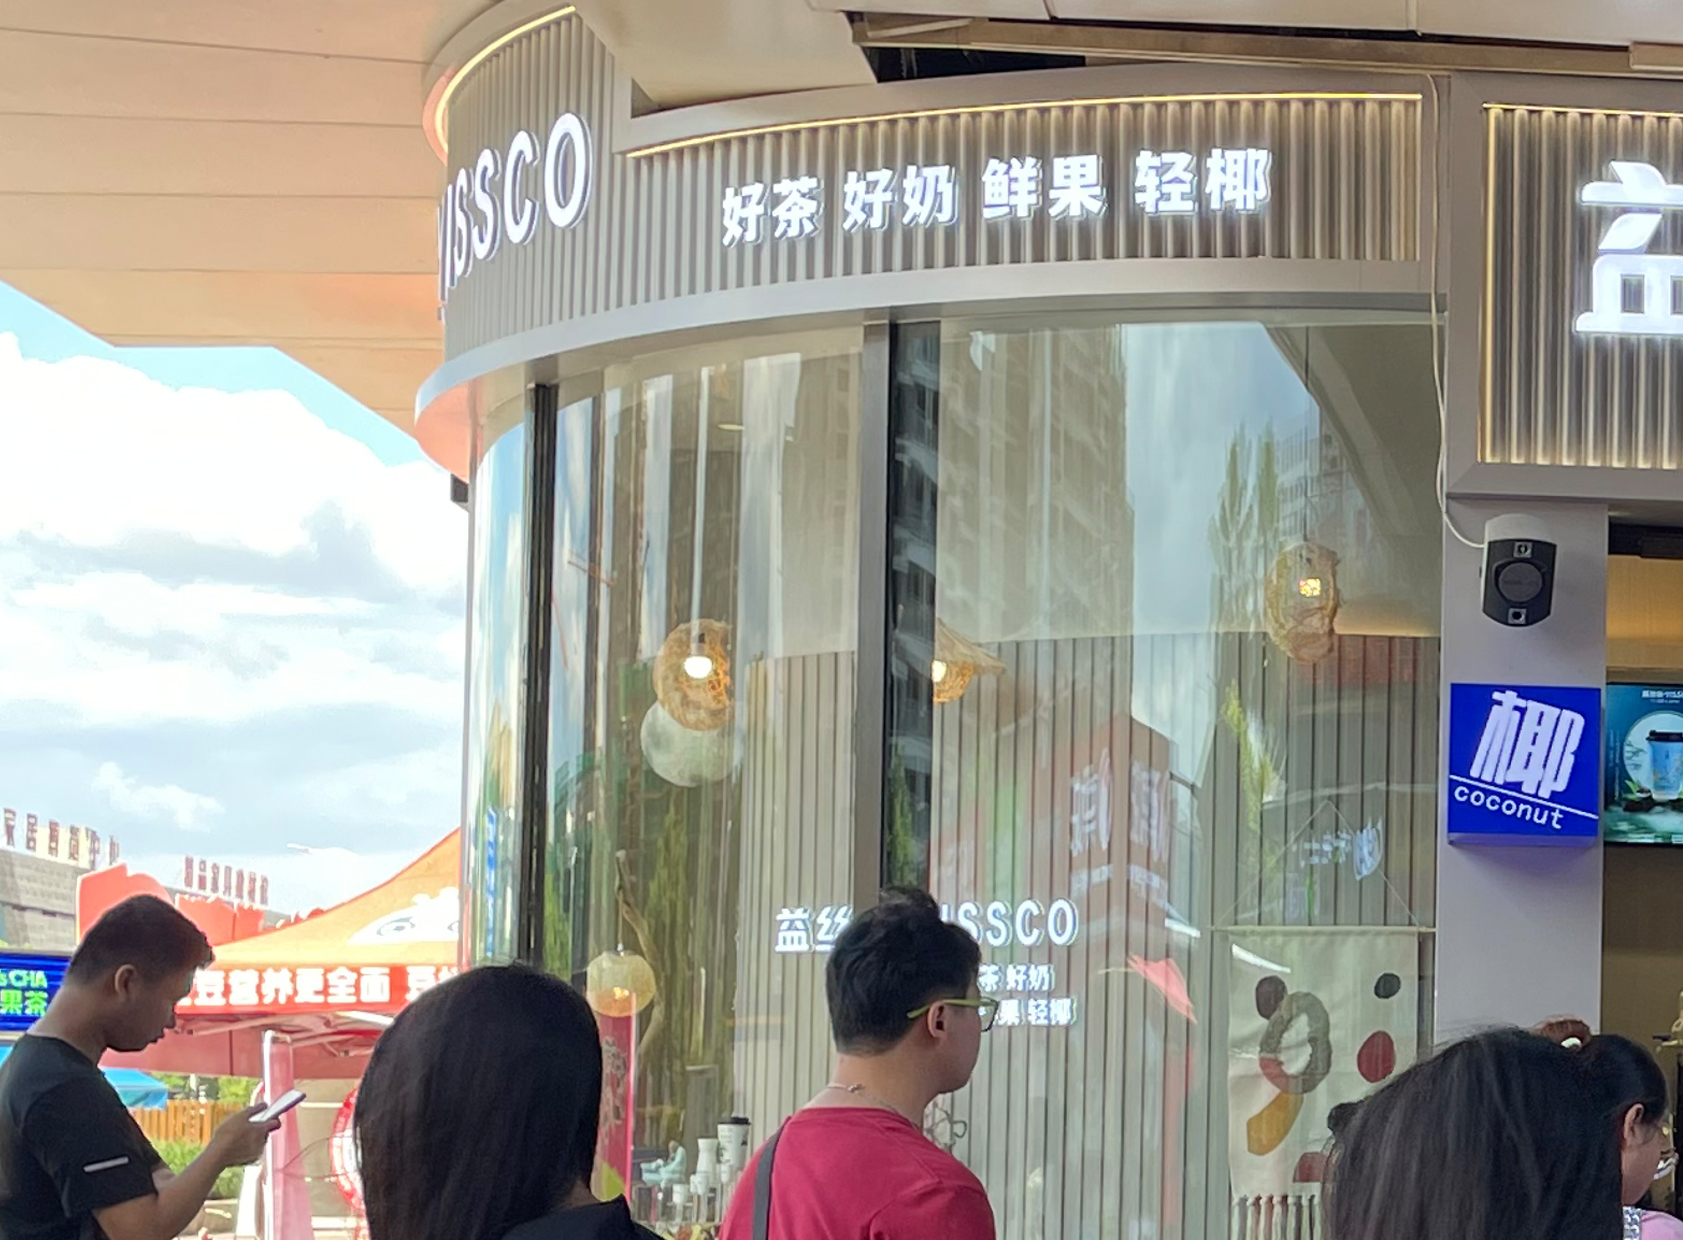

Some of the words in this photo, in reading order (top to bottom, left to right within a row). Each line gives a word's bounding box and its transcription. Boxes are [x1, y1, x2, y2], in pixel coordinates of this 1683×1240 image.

[722, 175, 824, 247] 好茶
[842, 164, 957, 232] 好奶
[981, 154, 1104, 220] 鲜果
[1134, 147, 1271, 215] 轻椰
[1470, 689, 1585, 799] 椰
[1454, 786, 1564, 830] coconut
[177, 967, 391, 1006] 豆营养更全面
[1006, 964, 1056, 991] 好奶
[1028, 998, 1077, 1026] 轻椰
